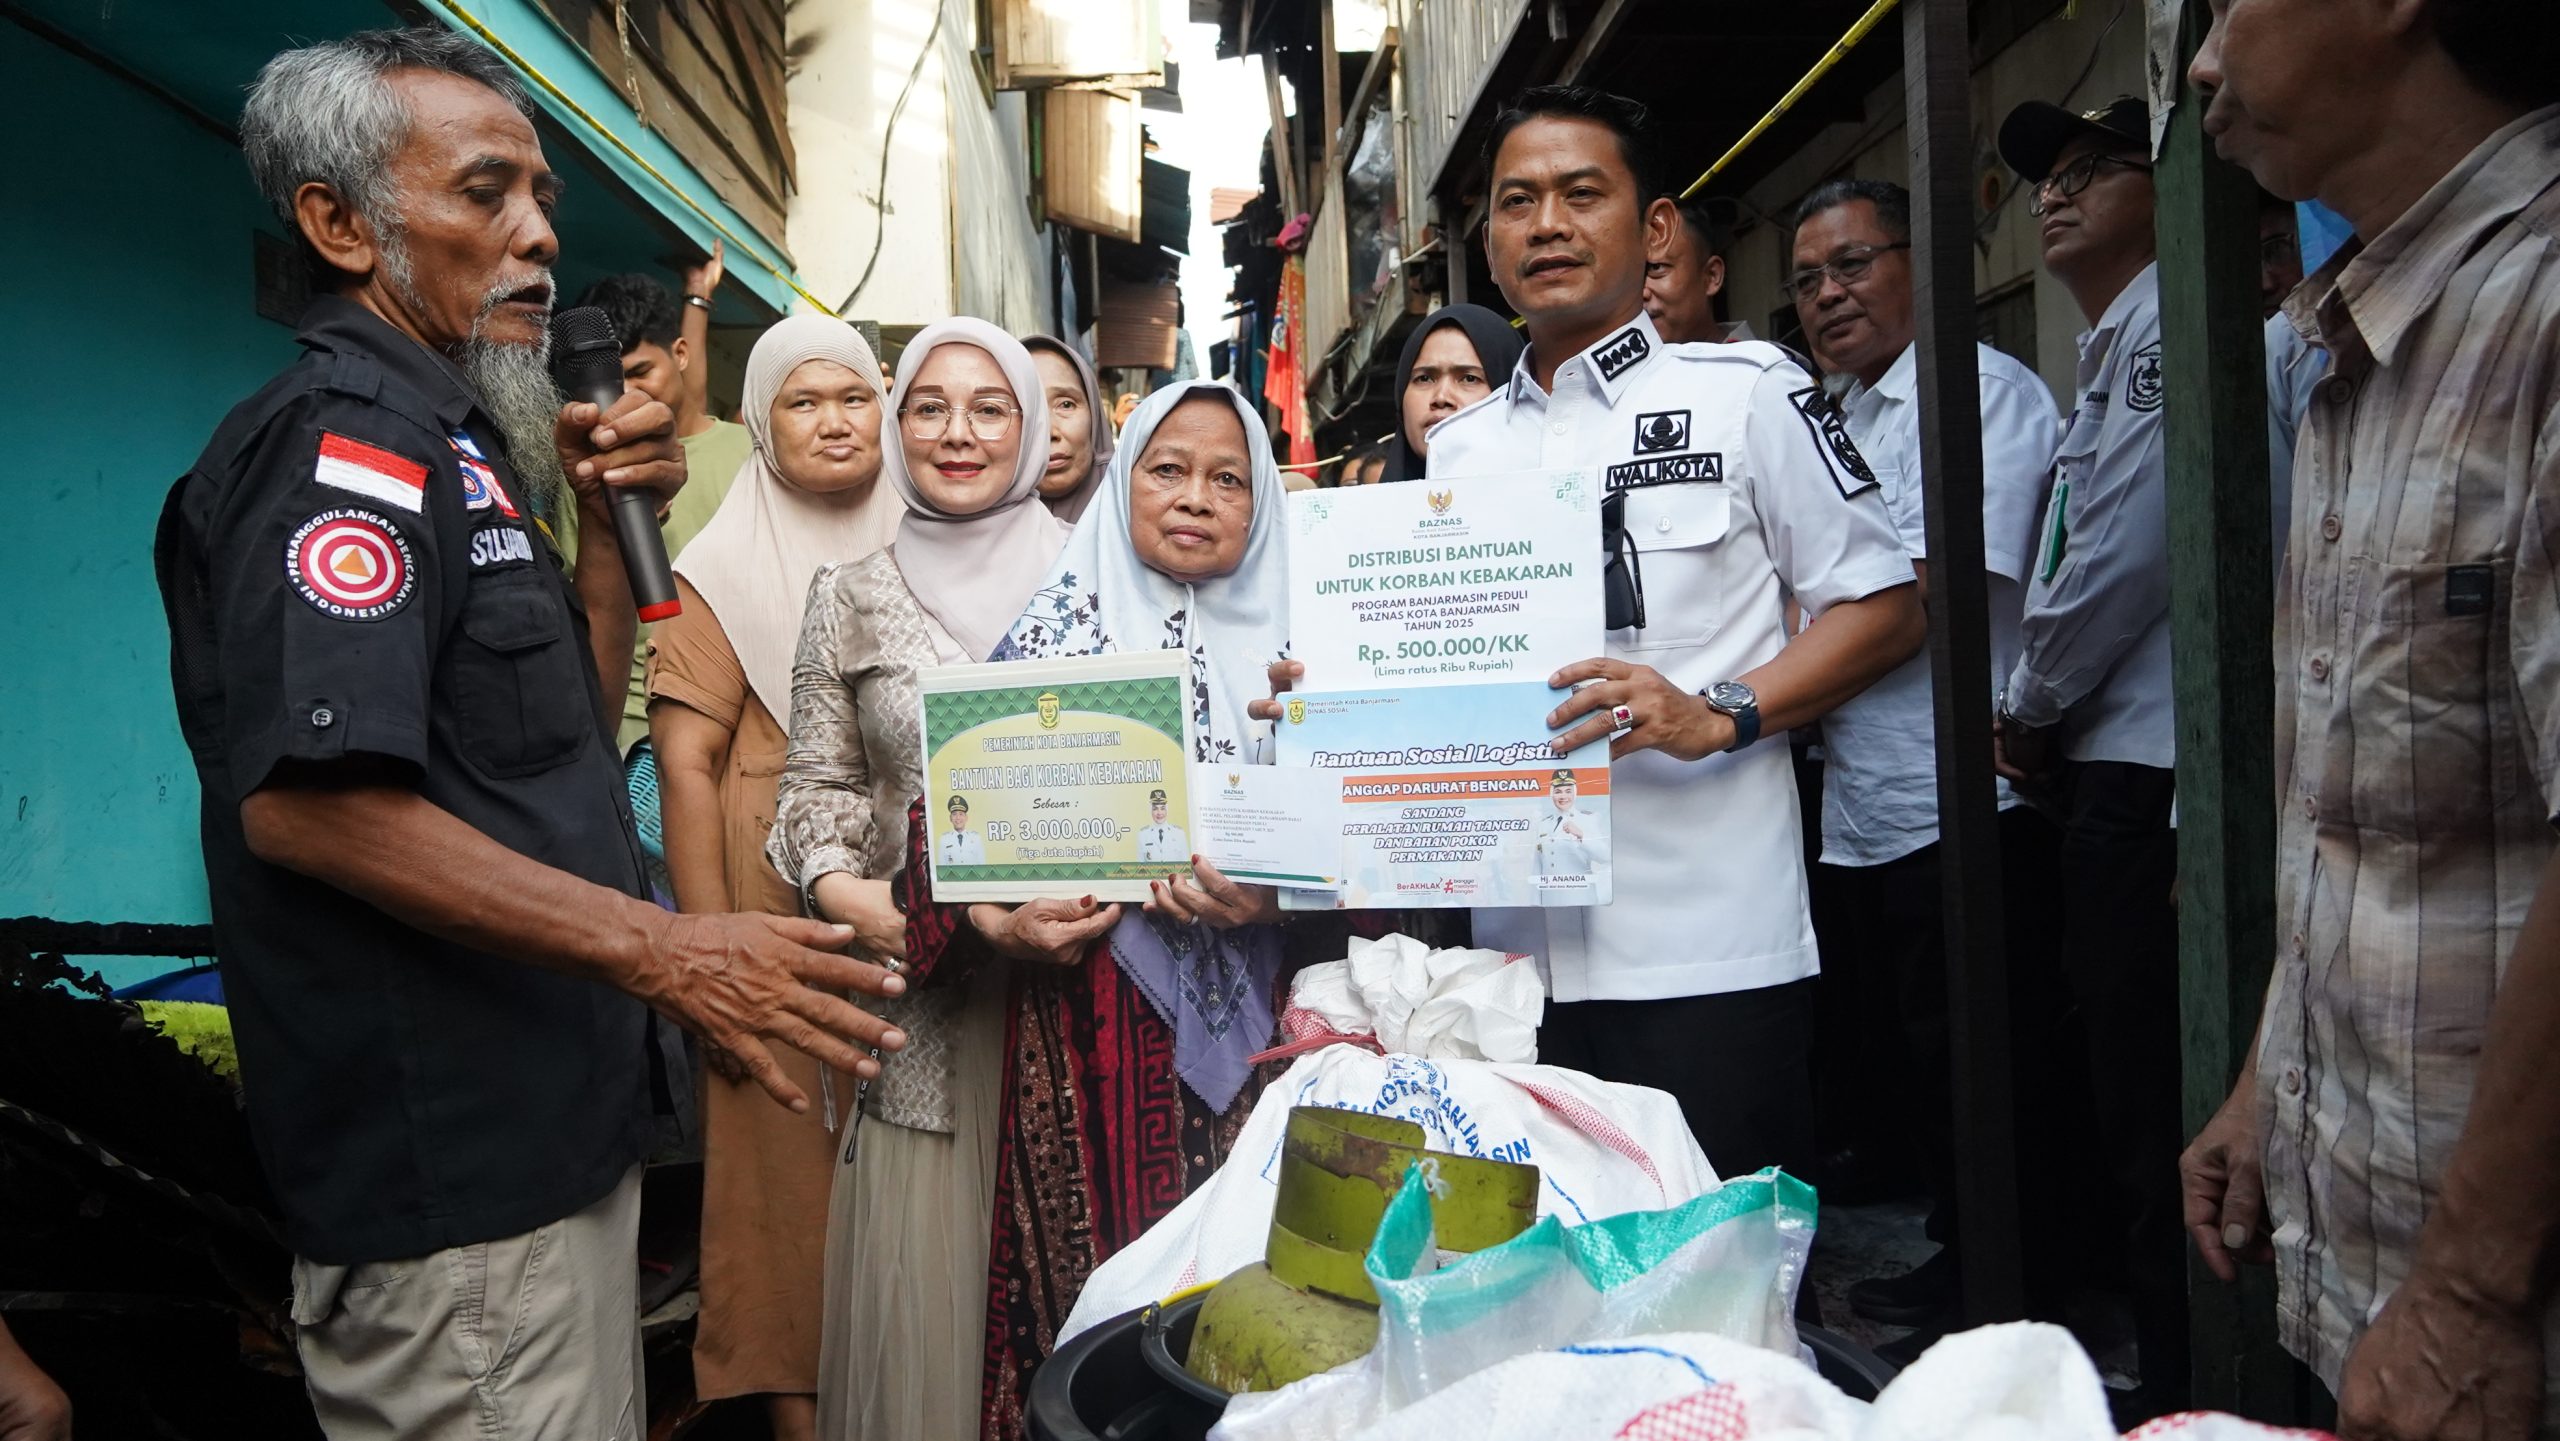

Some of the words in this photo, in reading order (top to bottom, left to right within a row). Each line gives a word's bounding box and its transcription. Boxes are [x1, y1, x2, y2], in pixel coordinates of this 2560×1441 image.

[1612, 456, 1717, 486] WALIKOTA
[1419, 517, 1463, 528] BAZNAS
[287, 509, 399, 576] PENANGGULANGAN
[395, 537, 415, 599] BENCANA
[1348, 548, 1441, 569] DISTRIBUSI
[1446, 540, 1532, 561] BANTUAN
[1316, 576, 1375, 595] UNTUK
[1379, 571, 1455, 591] KORBAN
[1460, 562, 1573, 585] KEBAKARAN
[300, 585, 396, 618] INDONESIA
[1351, 598, 1407, 611] PROGRAM
[1409, 593, 1488, 607] BANJARMASIN
[1491, 590, 1528, 601] PEDULI
[1359, 610, 1404, 622] BAZNAS
[1407, 608, 1438, 619] KOTA
[1440, 603, 1520, 617] BANJARMASIN
[1404, 620, 1442, 631] TAHUN
[1444, 618, 1474, 629] 2025
[1358, 644, 1390, 665] Rp.
[1396, 634, 1530, 660] 500.000/KK
[1374, 666, 1405, 677] (Lima
[1407, 665, 1438, 674] ratus
[1440, 662, 1466, 672] Ribu
[1469, 658, 1514, 673] Rupiah)
[983, 736, 1035, 752] PEMERINTAH
[1037, 734, 1059, 749] KOTA
[1060, 731, 1121, 748] BANJARMASIN
[1311, 750, 1403, 768] Bantuan
[1404, 744, 1473, 765] Sosial
[950, 766, 1004, 791] BANTUAN
[1006, 765, 1034, 789] BAGI
[1036, 761, 1086, 788] KORBAN
[1089, 759, 1163, 785] KEBAKARAN
[1342, 783, 1401, 797] ANGGAP
[1402, 781, 1469, 795] DARURAT
[1470, 779, 1539, 793] BENCANA
[1033, 798, 1071, 809] Sebesar
[1401, 807, 1465, 819] SANDANG
[987, 821, 1016, 841] RP.
[1019, 818, 1131, 841] 3.000.000,-
[1342, 823, 1421, 835] PERALATAN
[1421, 821, 1473, 833] RUMAH
[1473, 819, 1530, 831] TANGGA
[1374, 838, 1402, 849] DAN
[1402, 836, 1449, 848] BAHAN
[1451, 835, 1498, 847] POKOK
[1016, 847, 1040, 860] (Tiga
[1042, 847, 1064, 859] Juta
[1066, 845, 1104, 859] Rupiah)
[1389, 850, 1483, 863] PERMAKANAN
[1396, 882, 1441, 890] BerAKHLAK
